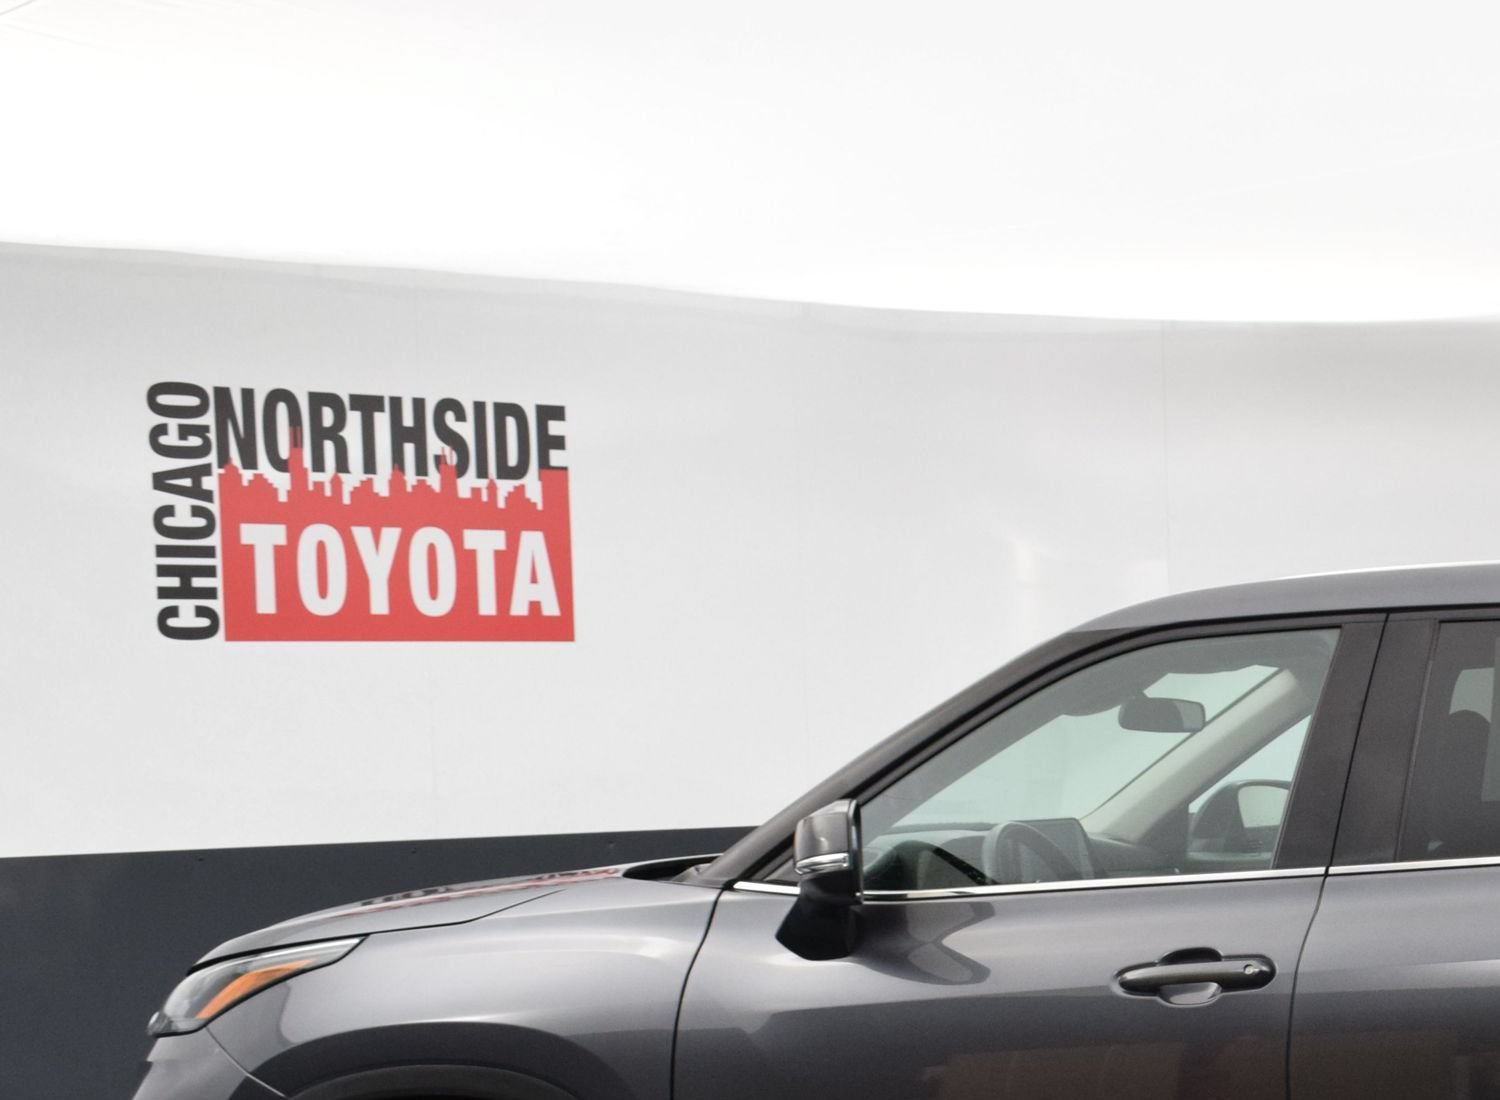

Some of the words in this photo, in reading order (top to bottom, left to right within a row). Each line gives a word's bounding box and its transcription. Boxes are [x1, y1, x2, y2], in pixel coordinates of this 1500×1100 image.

[213, 385, 568, 481] NORTHSIDE
[146, 381, 221, 641] CHICAGO
[240, 522, 562, 618] TOYOTA
